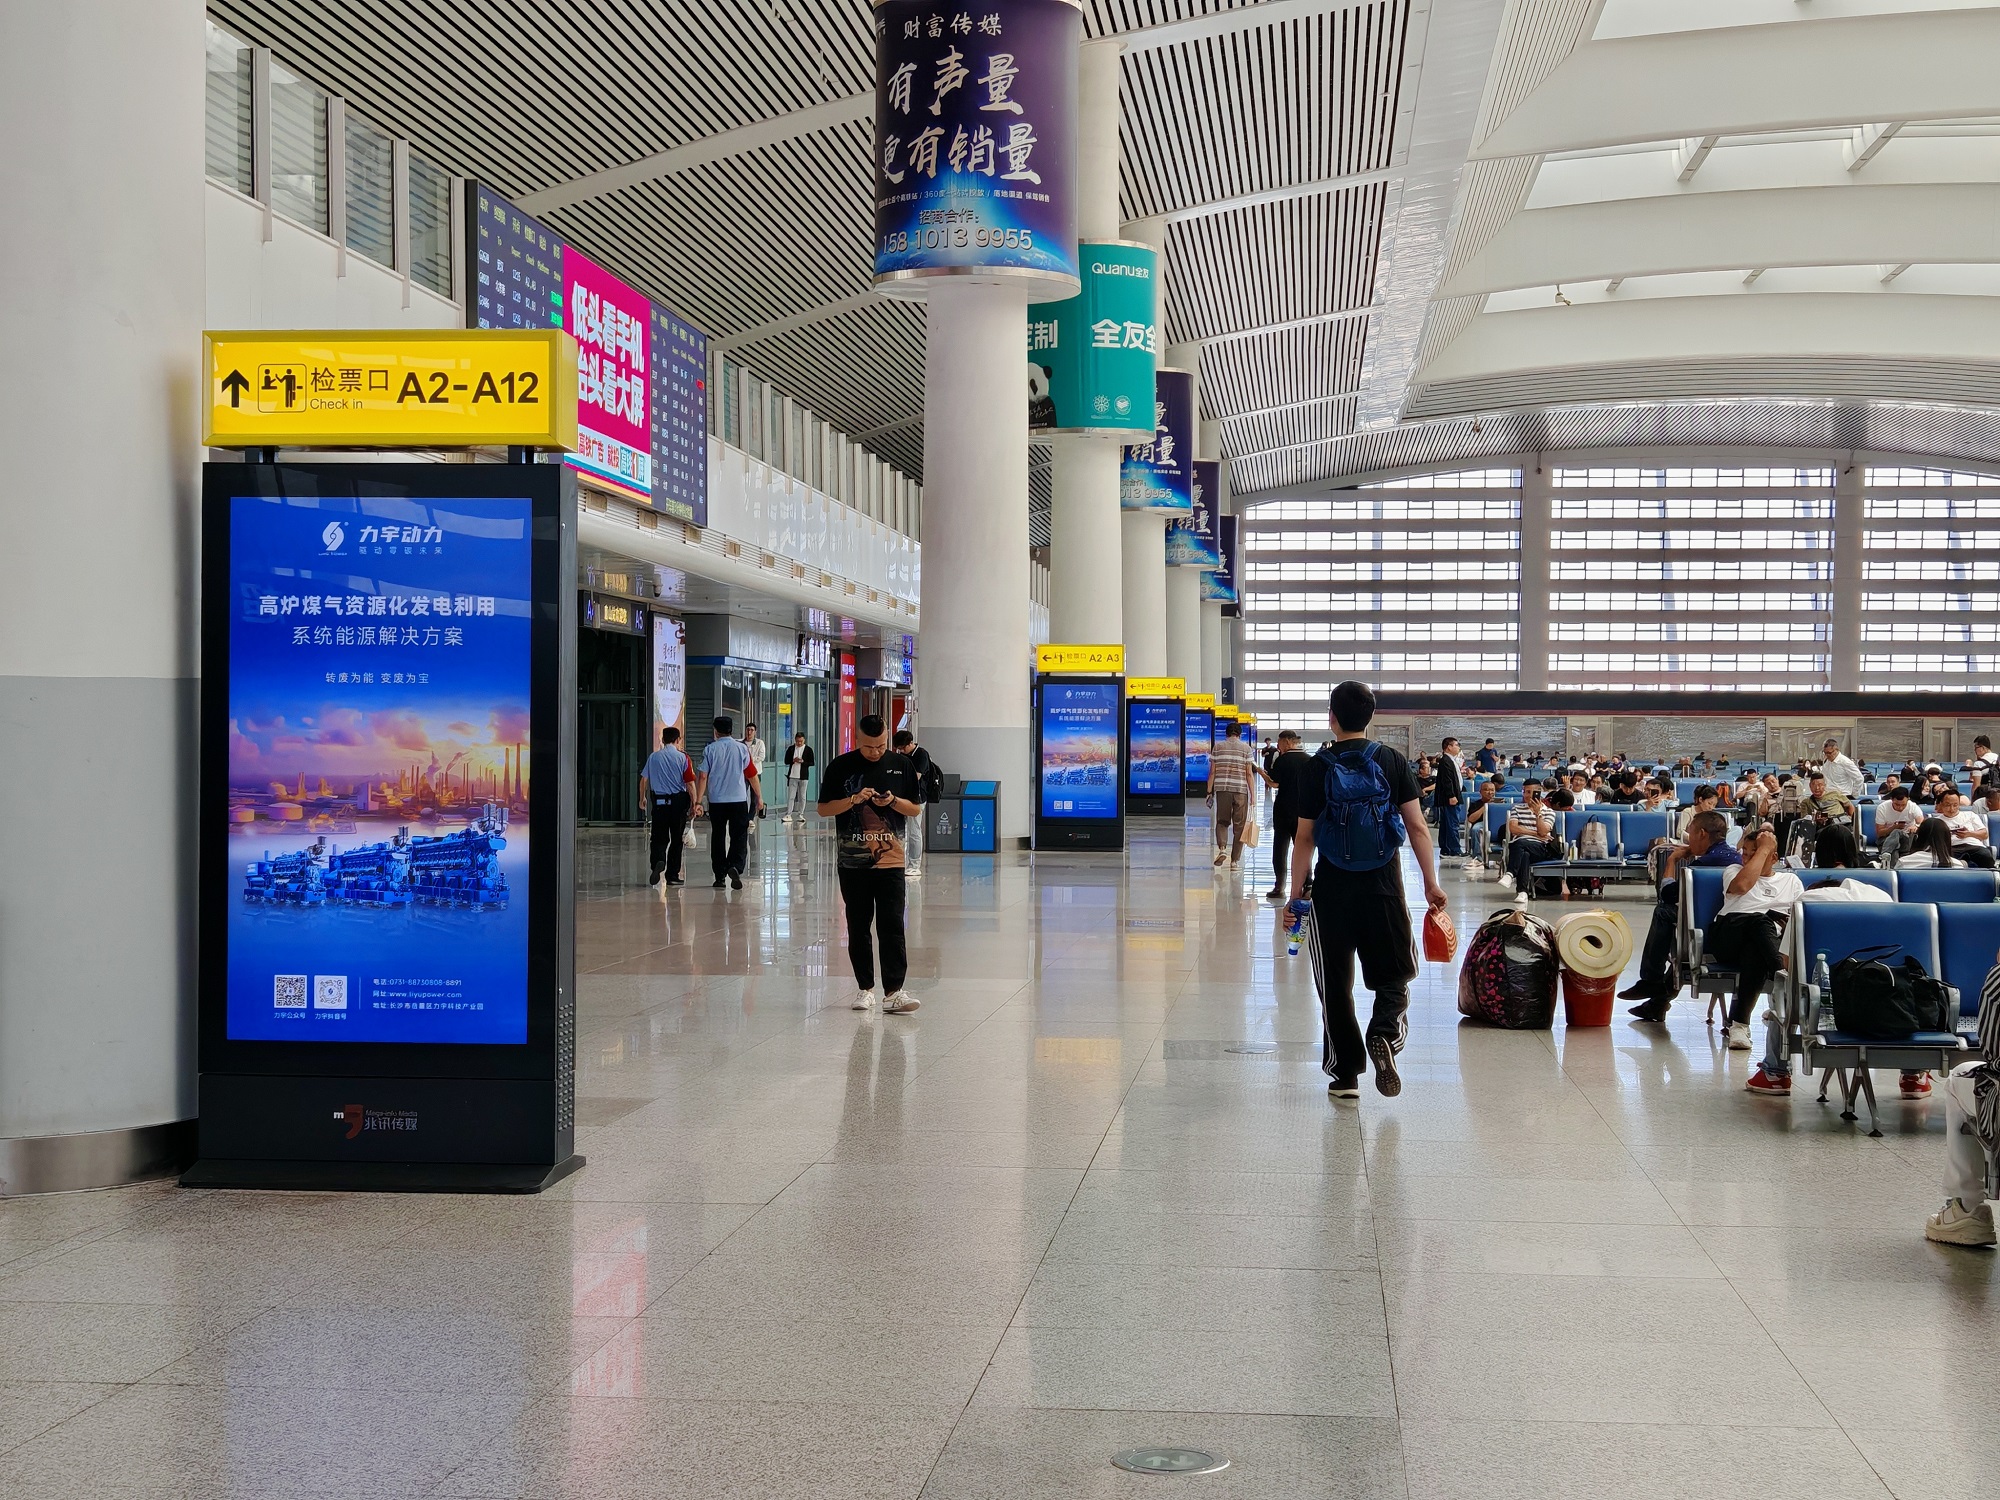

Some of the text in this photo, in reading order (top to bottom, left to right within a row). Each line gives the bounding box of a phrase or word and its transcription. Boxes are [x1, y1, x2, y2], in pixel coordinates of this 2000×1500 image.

[903, 11, 1002, 40] 财富传媒
[886, 44, 1024, 116] 有声量
[881, 122, 1042, 185] 更有销量
[883, 227, 1033, 255] 158 1013 9955
[571, 280, 645, 374] 低头看手机
[310, 366, 539, 404] 检票口 A2-A12
[310, 398, 363, 410] Check in
[1120, 435, 1177, 466] 销量
[359, 525, 443, 543] 力宇动力
[258, 594, 496, 616] 高炉煤气资源化发电利用
[291, 625, 464, 646] 系统能源解决方案
[325, 672, 429, 684] 转废为能 变废为宝
[852, 832, 894, 842] PRIORITY
[363, 1117, 418, 1131] 兆讯传媒
